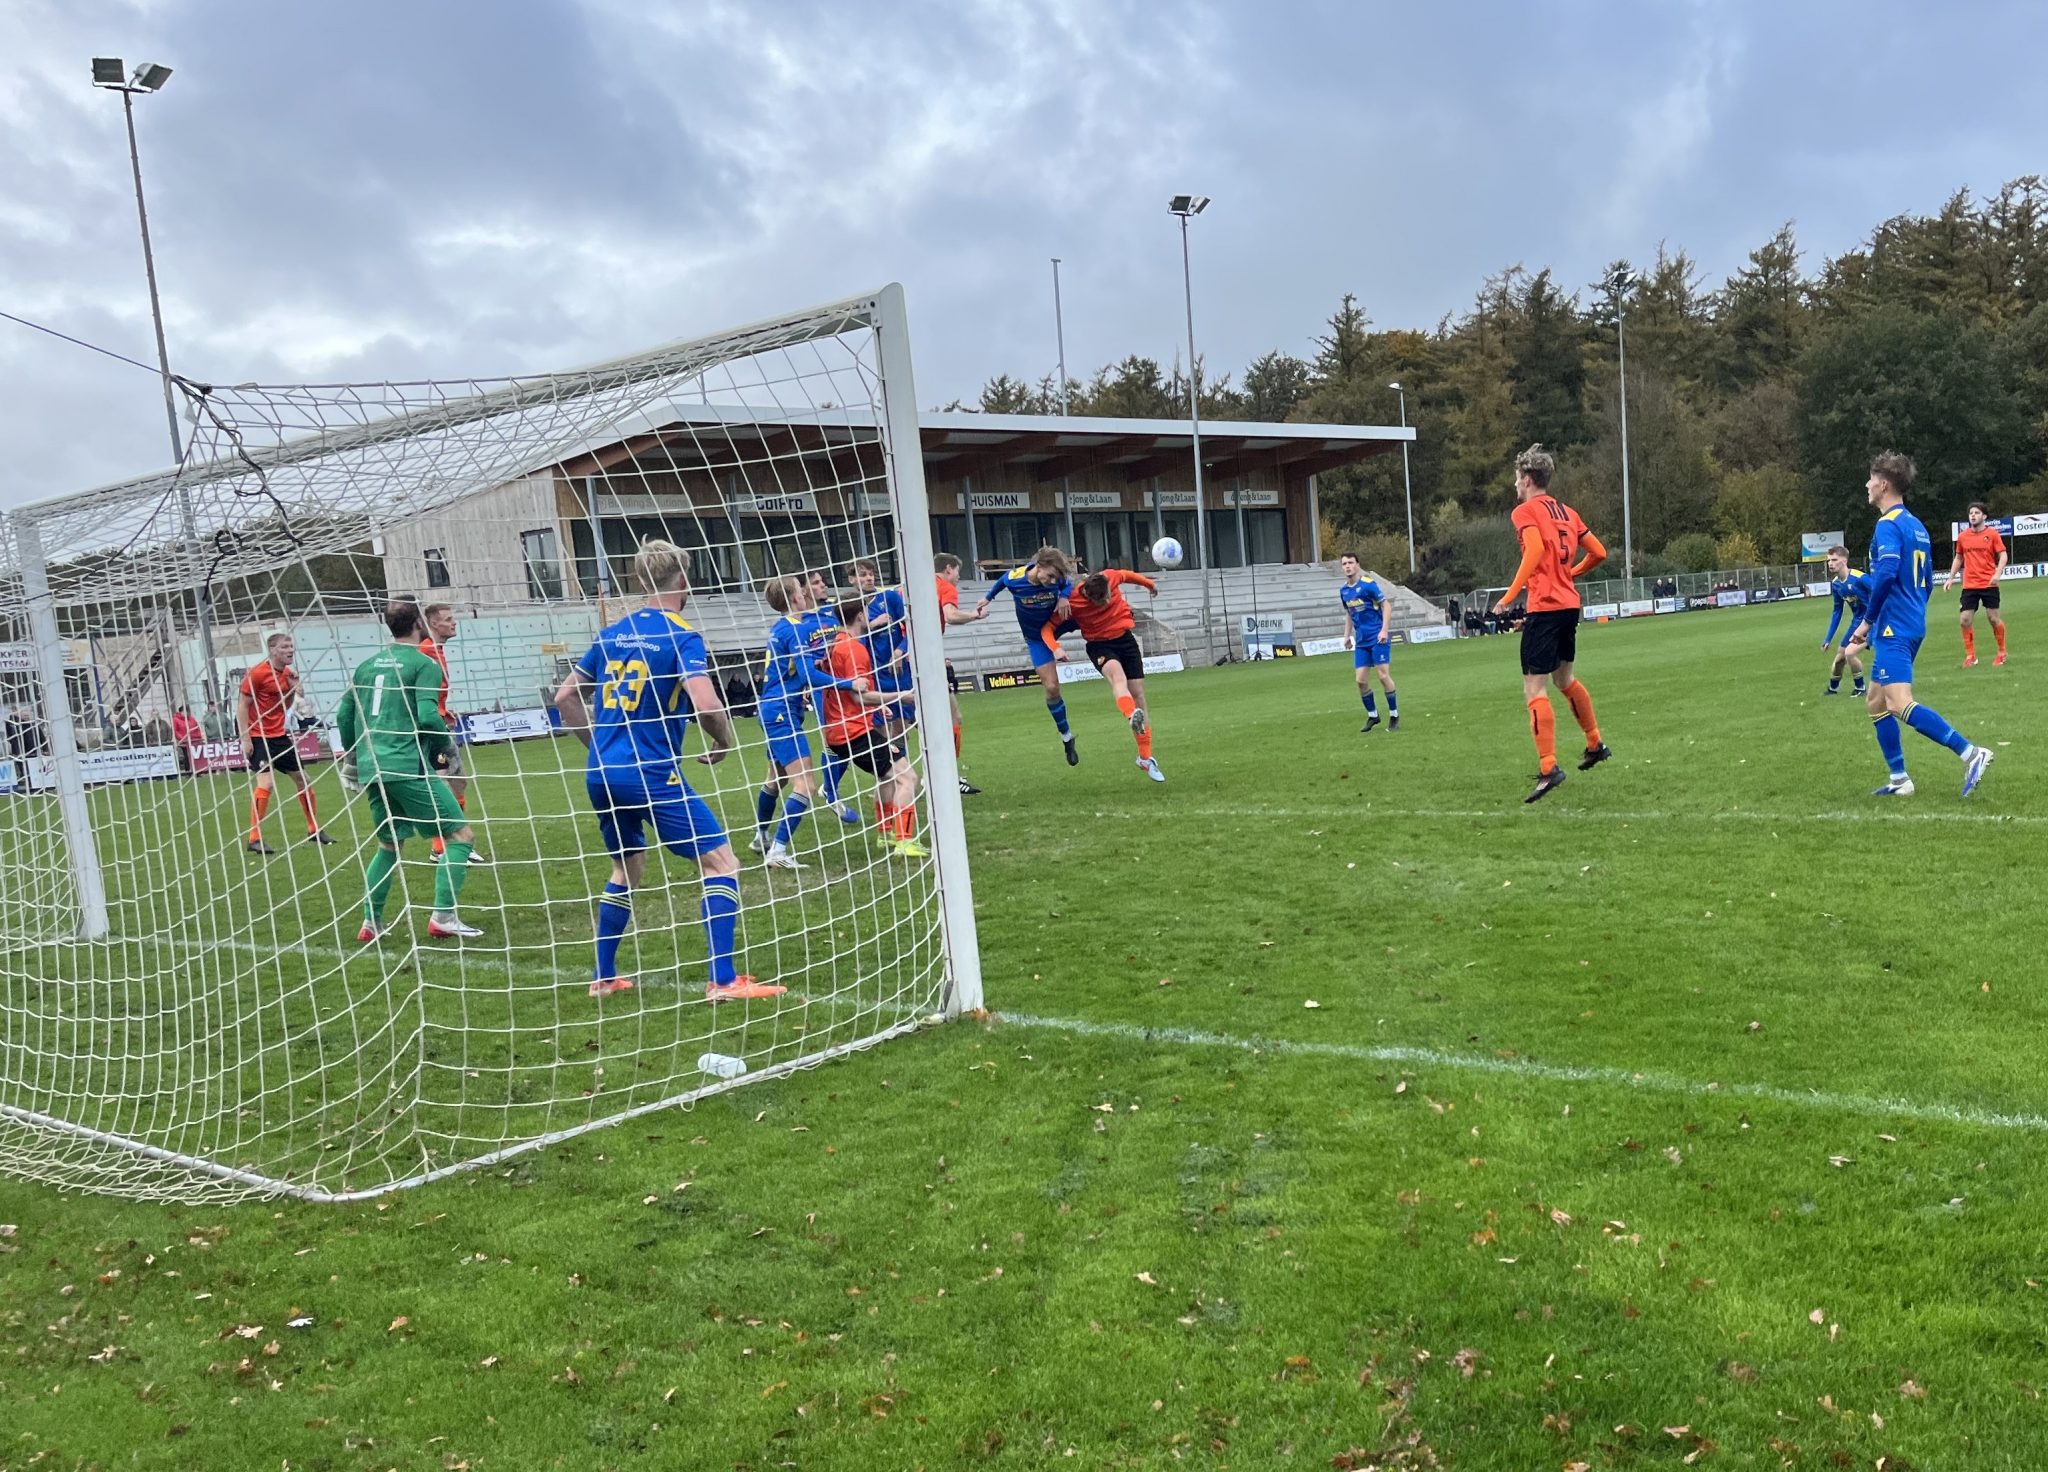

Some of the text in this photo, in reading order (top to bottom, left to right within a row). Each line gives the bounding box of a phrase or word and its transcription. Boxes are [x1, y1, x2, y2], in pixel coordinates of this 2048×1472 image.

[971, 495, 1019, 507] HUISMAN
[1559, 530, 1569, 564] 5
[371, 674, 385, 716] 1
[603, 659, 648, 712] 23
[190, 741, 243, 760] VENE
